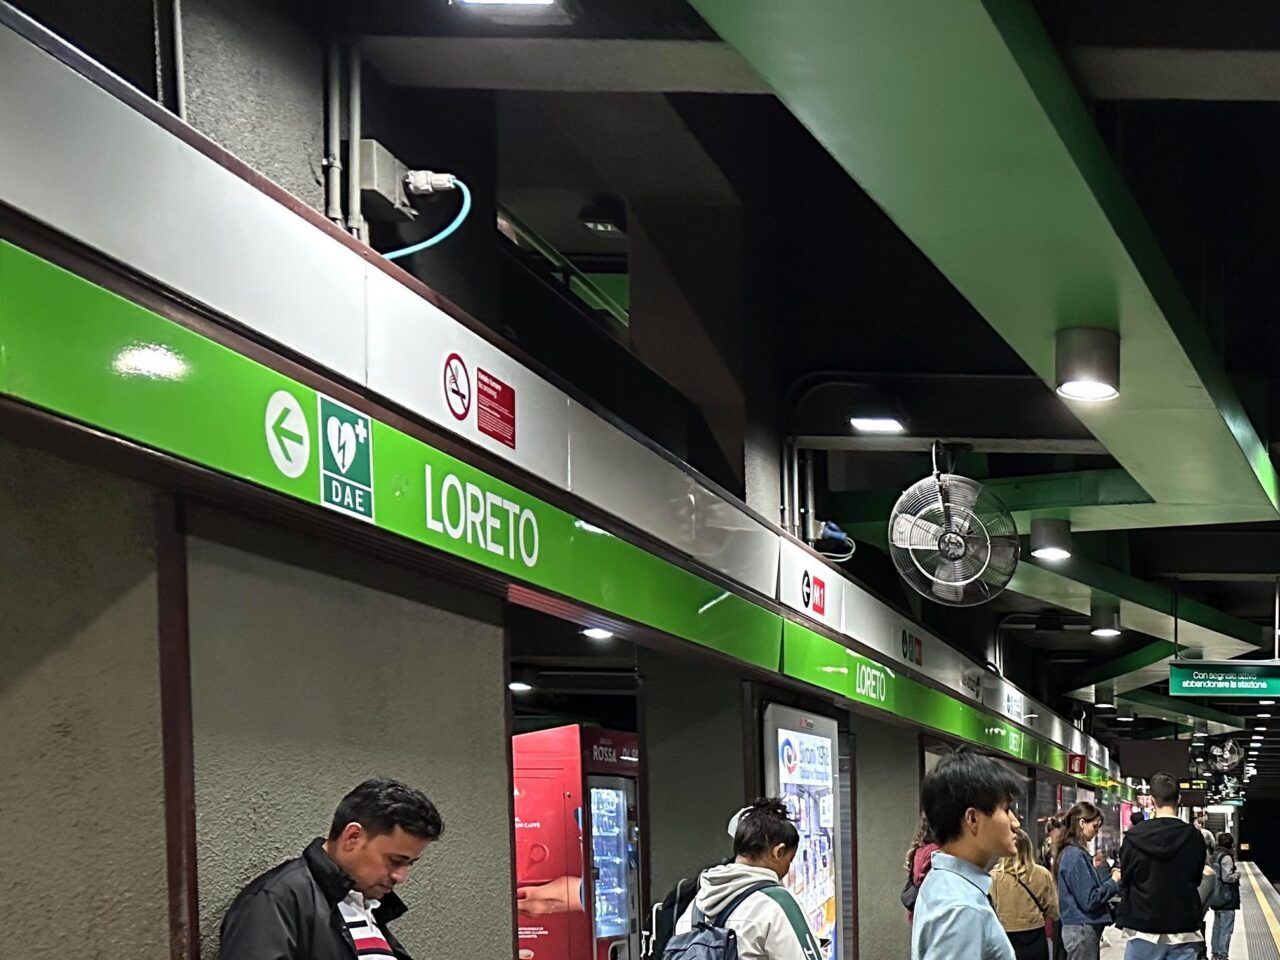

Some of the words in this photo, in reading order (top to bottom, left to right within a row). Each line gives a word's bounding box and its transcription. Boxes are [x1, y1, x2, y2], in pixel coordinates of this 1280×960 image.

[332, 480, 365, 512] DAE
[425, 464, 539, 568] LORETO
[856, 662, 886, 702] LORETO
[1182, 680, 1230, 688] abbandonare
[1237, 680, 1268, 689] stazione
[1193, 671, 1208, 680] Con
[593, 744, 617, 762] ROSSA
